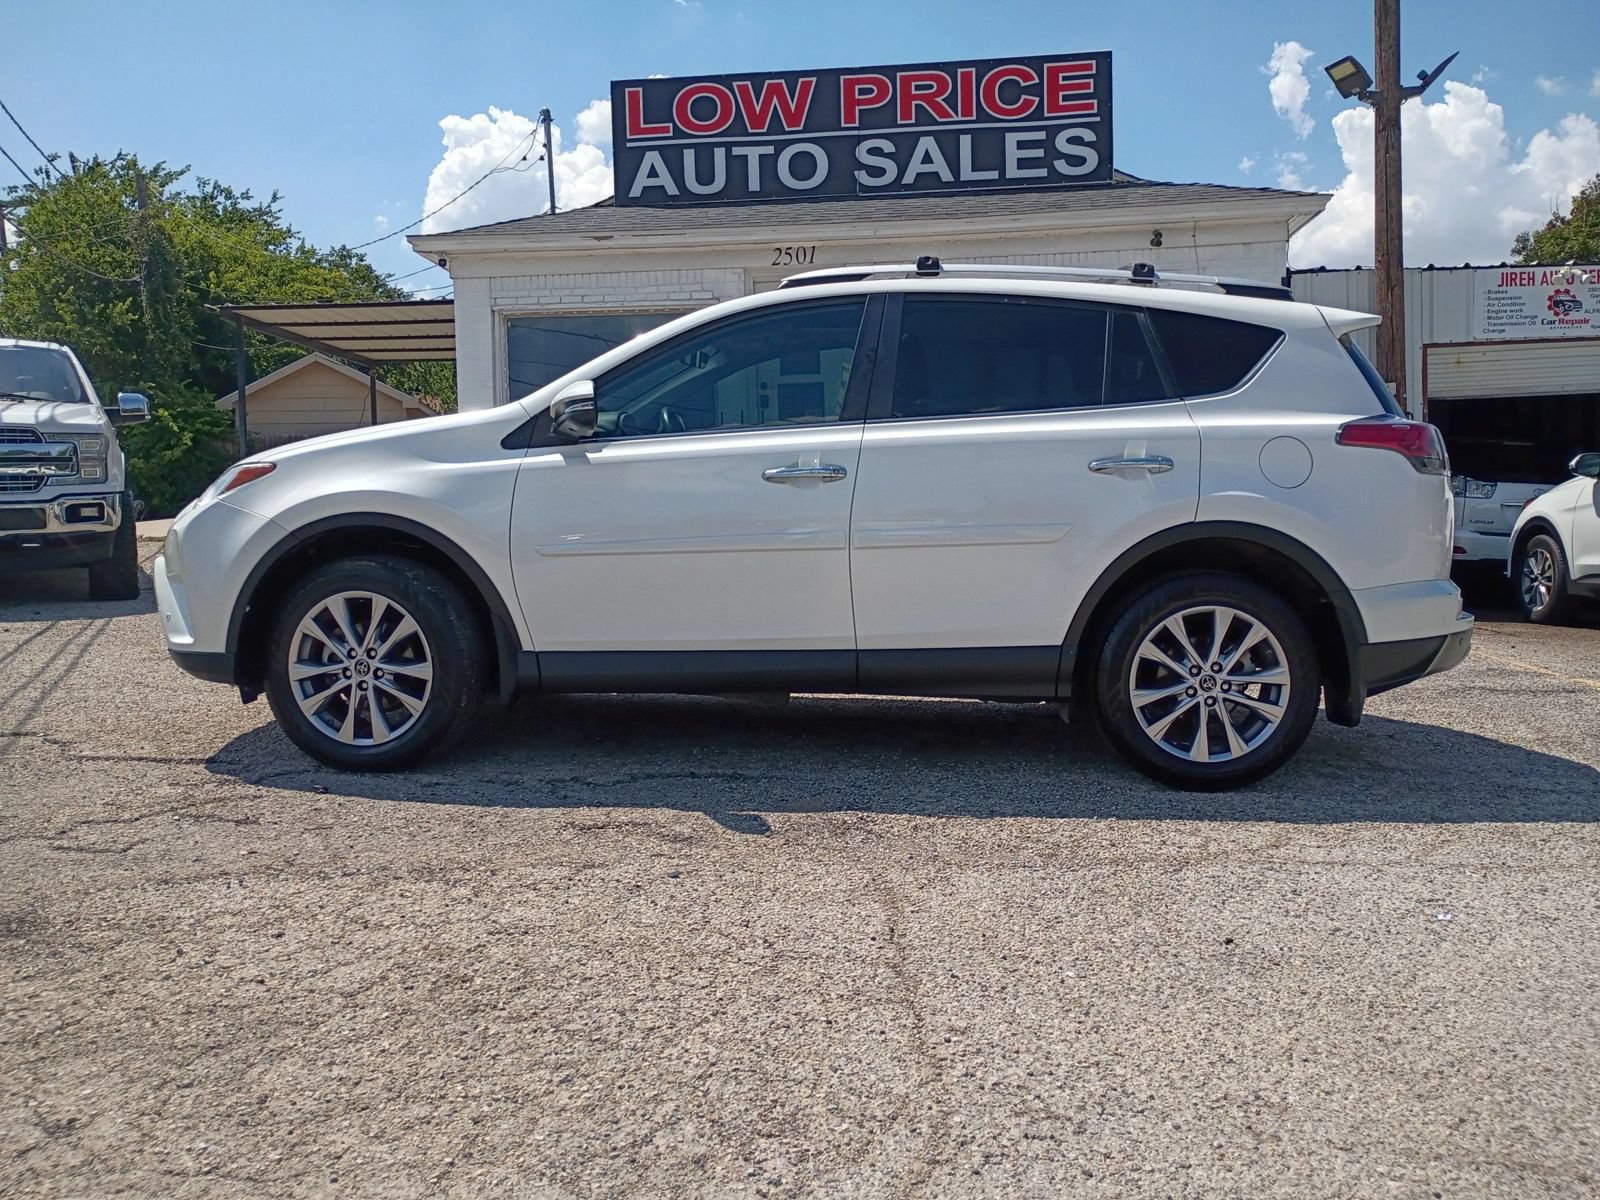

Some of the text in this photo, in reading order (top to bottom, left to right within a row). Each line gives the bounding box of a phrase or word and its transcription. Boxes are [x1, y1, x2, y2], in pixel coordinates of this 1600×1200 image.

[625, 60, 1098, 139] LOW PRICE
[628, 127, 1099, 198] AUTO SALES
[771, 245, 816, 266] 2501
[1498, 271, 1535, 287] JIREH
[1541, 317, 1591, 326] Car Repair
